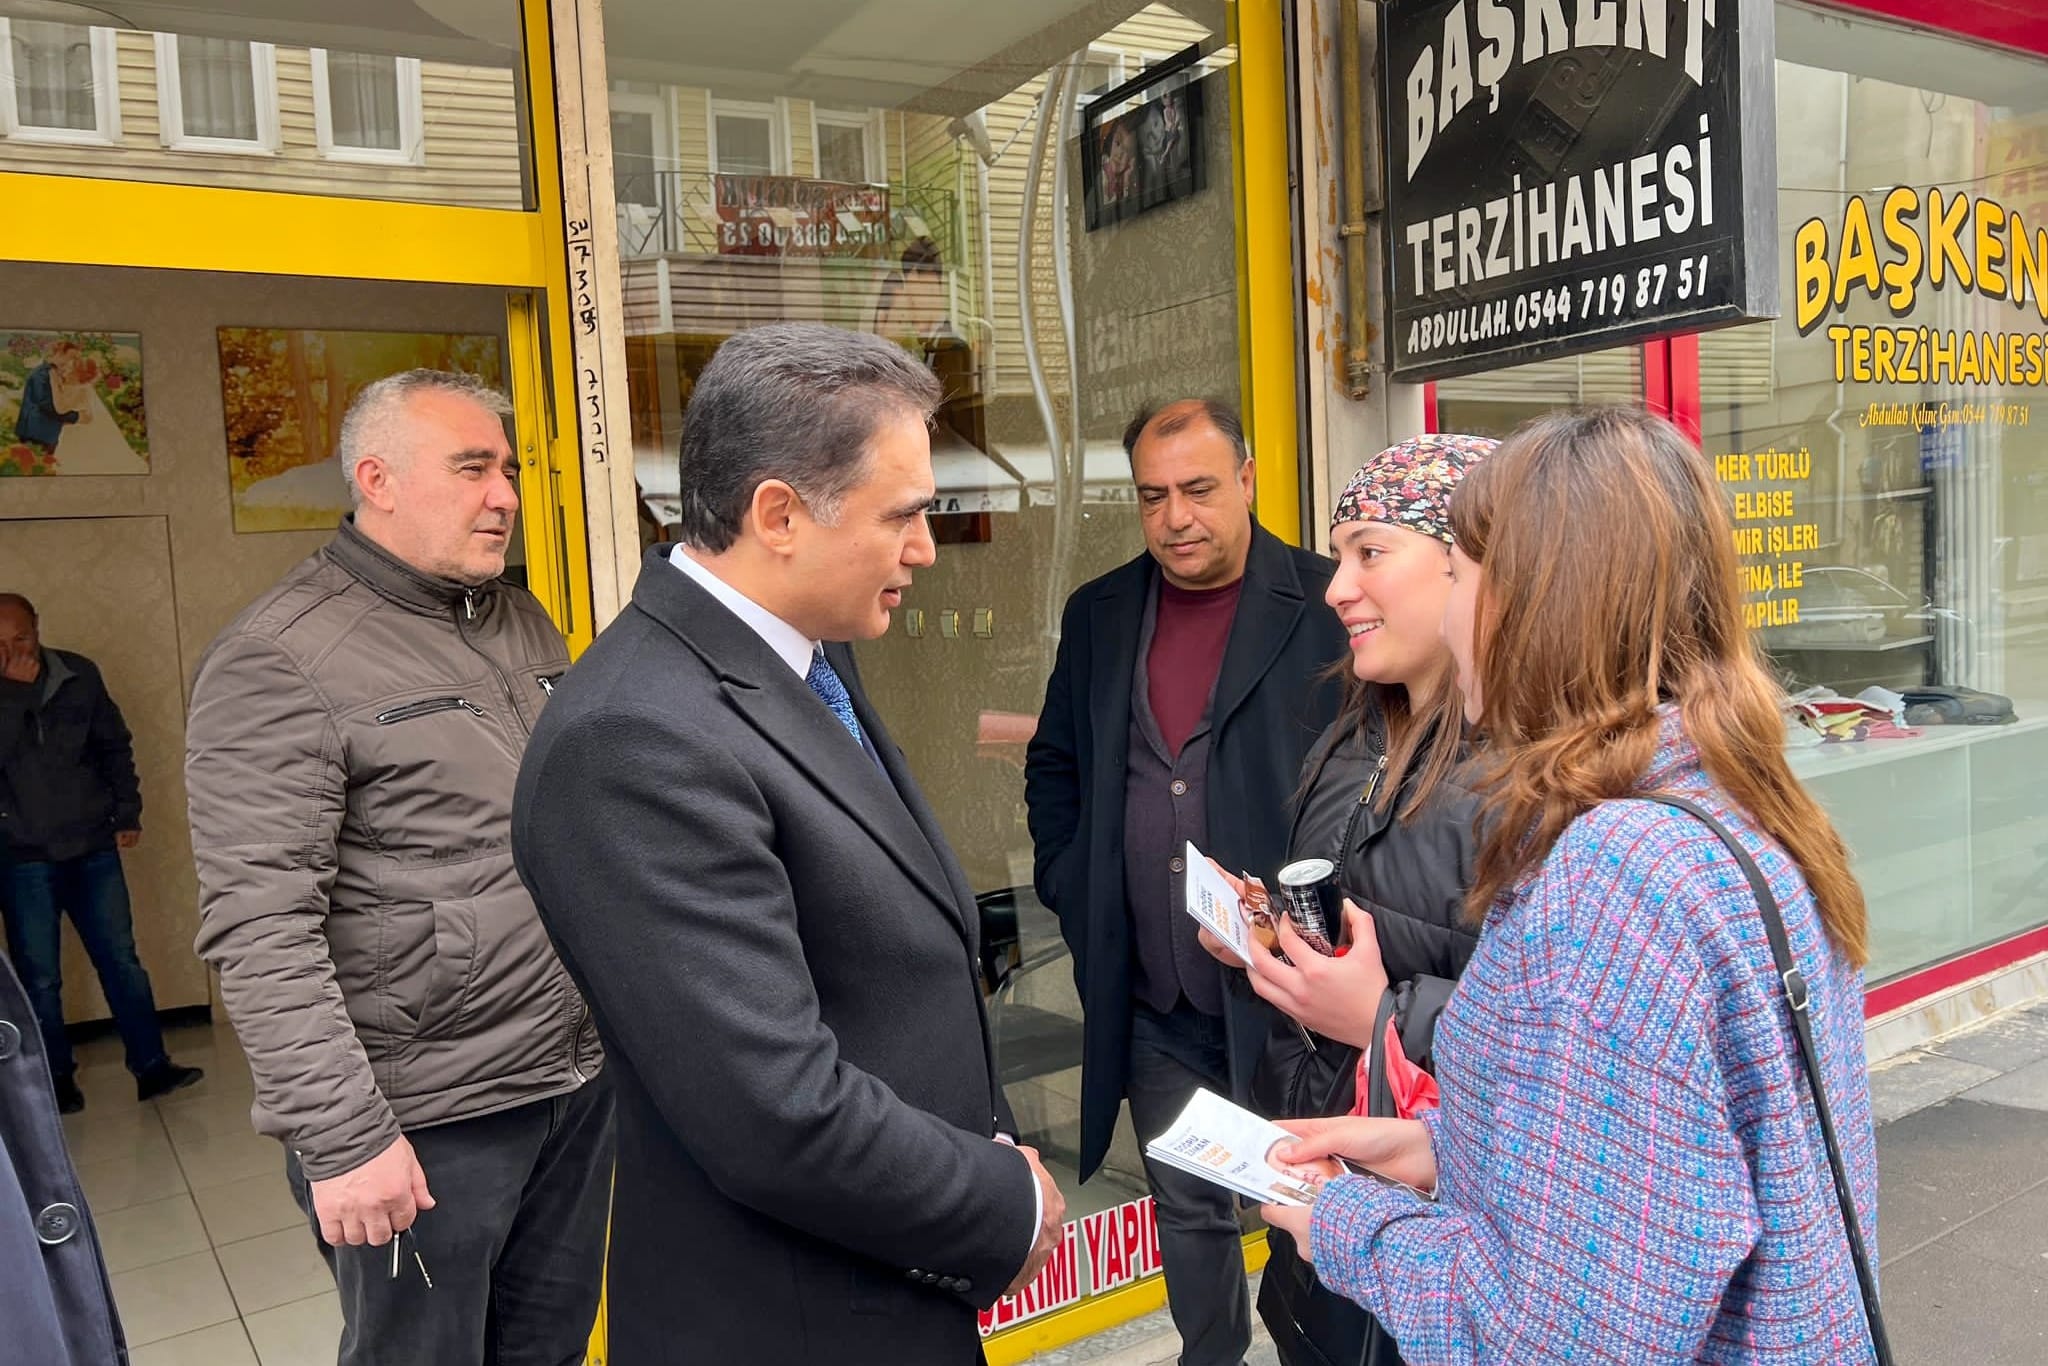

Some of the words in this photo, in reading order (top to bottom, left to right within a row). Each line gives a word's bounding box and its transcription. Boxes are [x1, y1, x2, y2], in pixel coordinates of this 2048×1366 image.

[1407, 113, 1713, 296] TERZİHANESİ
[1581, 272, 1626, 319] 719
[1635, 264, 1668, 308] 87
[1677, 254, 1709, 301] 51
[1715, 454, 1751, 482] HER
[1755, 447, 1810, 481] TÜRLÜ
[1735, 490, 1793, 520] ELBİSE
[1731, 526, 1763, 555] MİR
[1767, 523, 1819, 559] İŞLERİ
[1778, 561, 1804, 589] İLE
[1081, 1195, 1163, 1296] YAPIL
